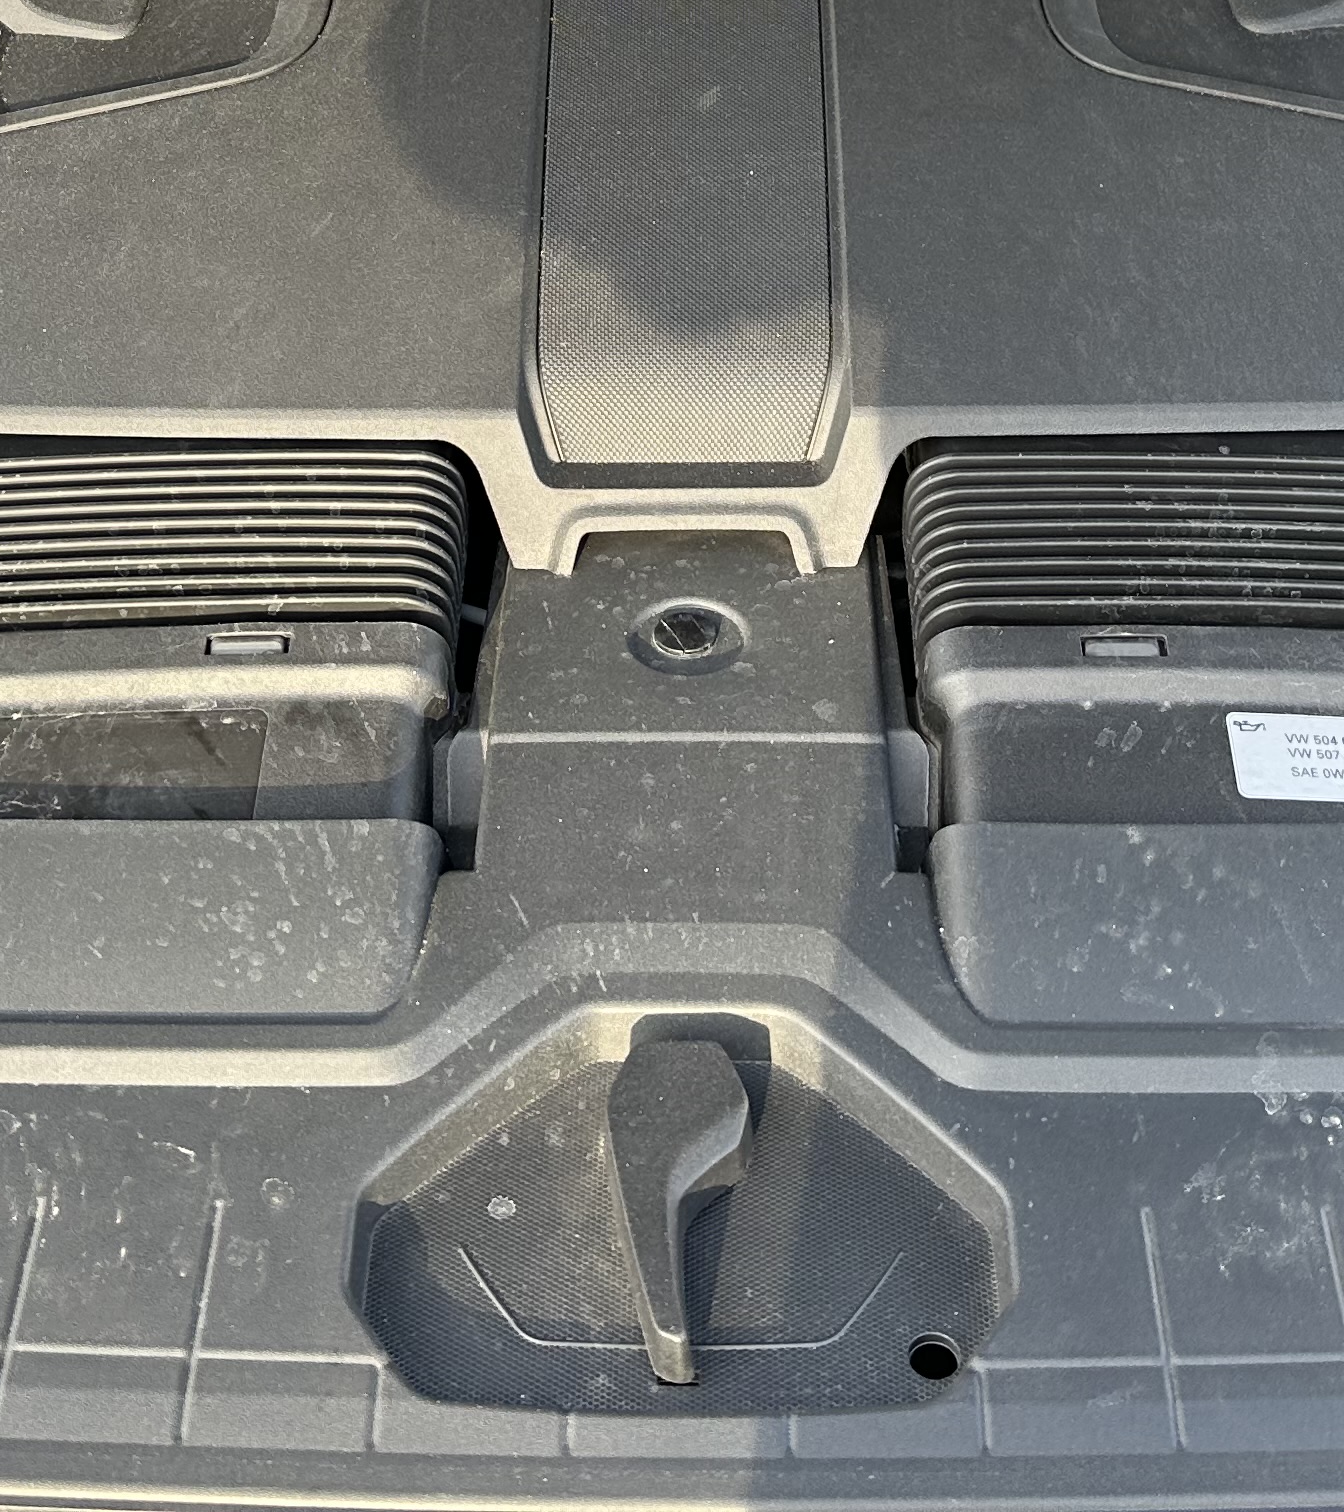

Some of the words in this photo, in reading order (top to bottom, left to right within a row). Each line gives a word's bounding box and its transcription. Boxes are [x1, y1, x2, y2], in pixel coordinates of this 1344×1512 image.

[1284, 733, 1309, 744] VW
[1313, 735, 1338, 745] 504
[1287, 748, 1311, 759] VW
[1316, 749, 1339, 760] 507
[1290, 766, 1319, 778] SAE
